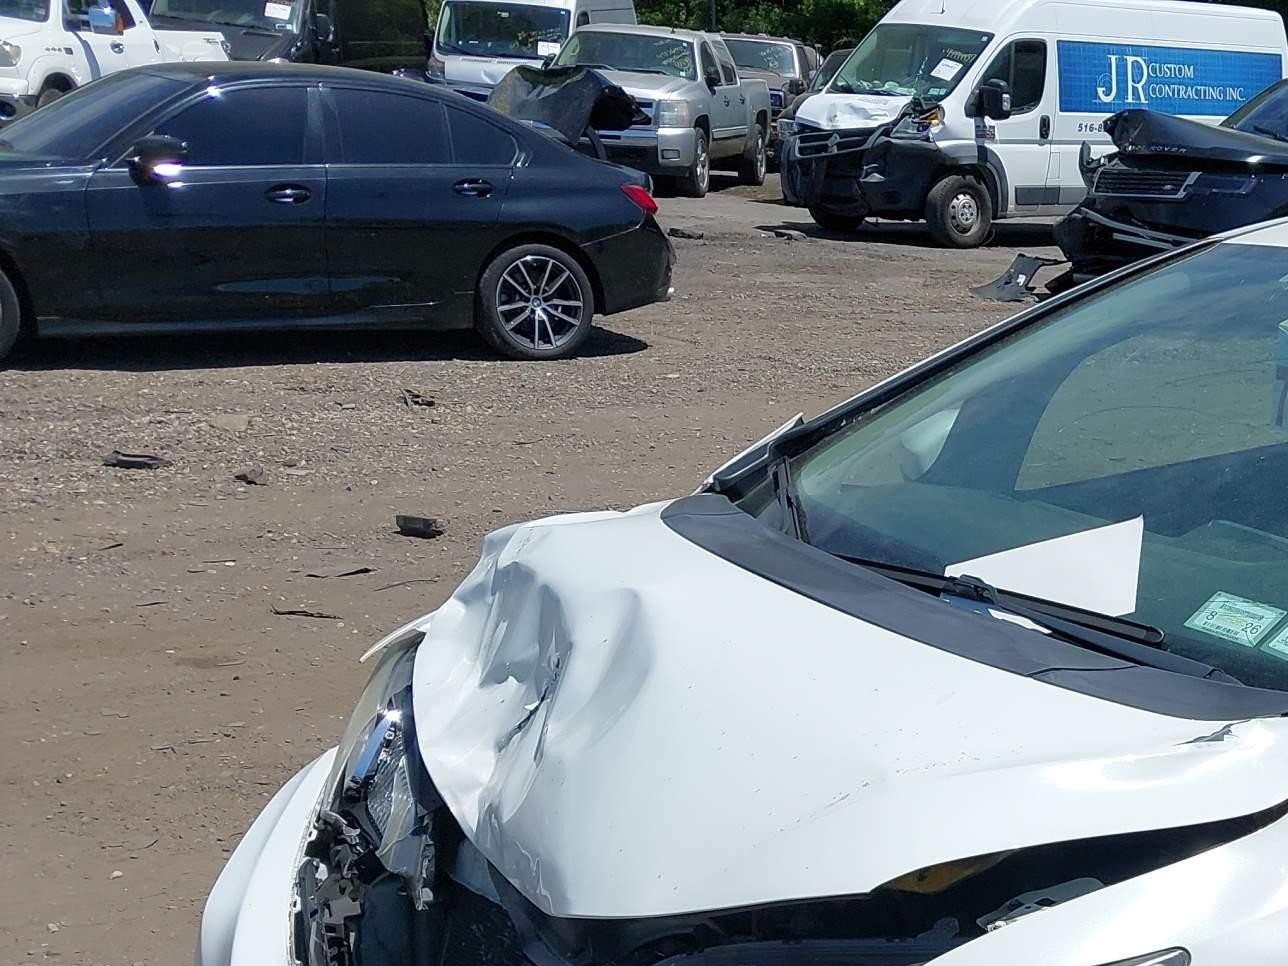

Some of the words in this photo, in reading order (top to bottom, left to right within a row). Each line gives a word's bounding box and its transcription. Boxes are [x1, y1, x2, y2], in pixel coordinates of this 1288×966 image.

[1149, 63, 1194, 78] CUSTOM
[1149, 84, 1223, 100] CONTRACTING
[1226, 88, 1246, 100] INC.
